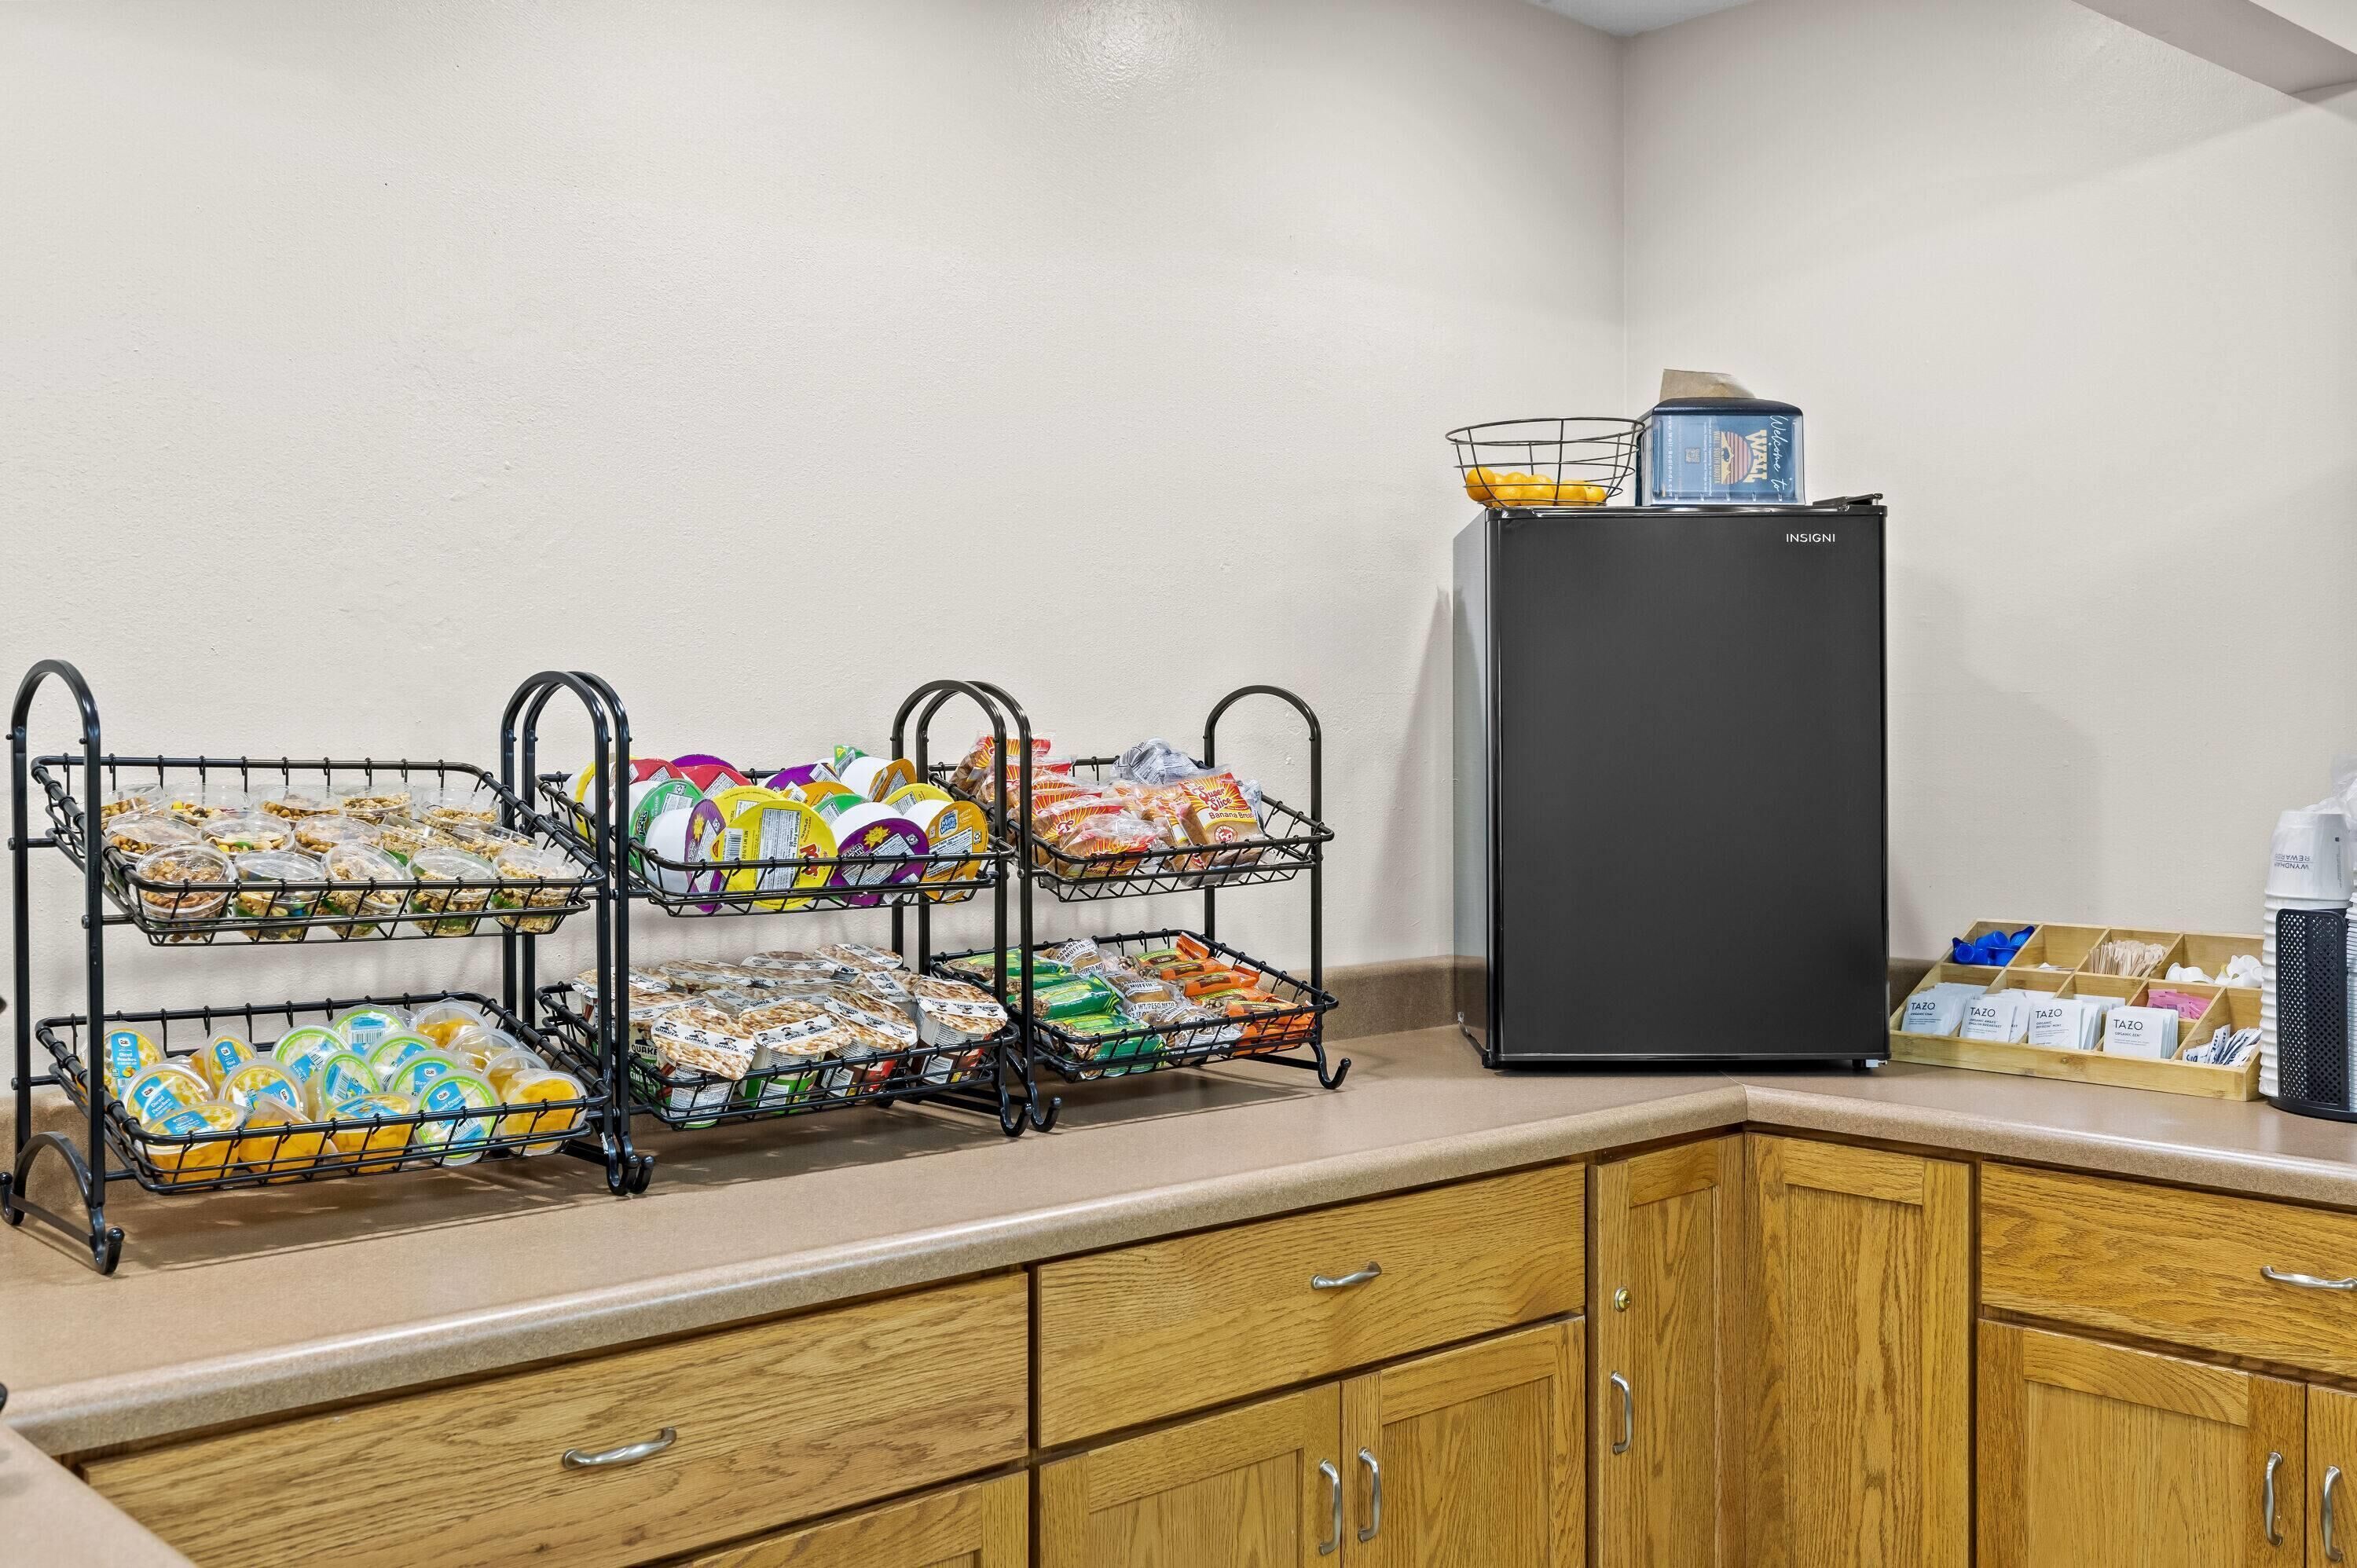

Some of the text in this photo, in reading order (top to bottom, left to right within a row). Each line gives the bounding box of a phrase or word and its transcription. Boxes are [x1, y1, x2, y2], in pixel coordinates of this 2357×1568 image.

[1743, 430, 1768, 483] WALL
[1769, 415, 1789, 493] Welcome to
[1786, 533, 1835, 543] INSIGNI
[1210, 797, 1233, 811] Slice
[1056, 942, 1076, 960] BANANA
[1911, 1002, 1936, 1010] TAZO
[1970, 1007, 1996, 1017] TAZO
[2035, 1009, 2062, 1019] TAZO
[2113, 1019, 2143, 1031] TAZO
[655, 1027, 680, 1038] QUAKER
[684, 1035, 710, 1046] QUAKER
[631, 1045, 658, 1055] QUAKE
[714, 1043, 739, 1053] QUAKER
[676, 1066, 698, 1077] Nutrition
[151, 1095, 165, 1108] Diced
[448, 1095, 463, 1105] Pears
[151, 1098, 171, 1114] Peaches
